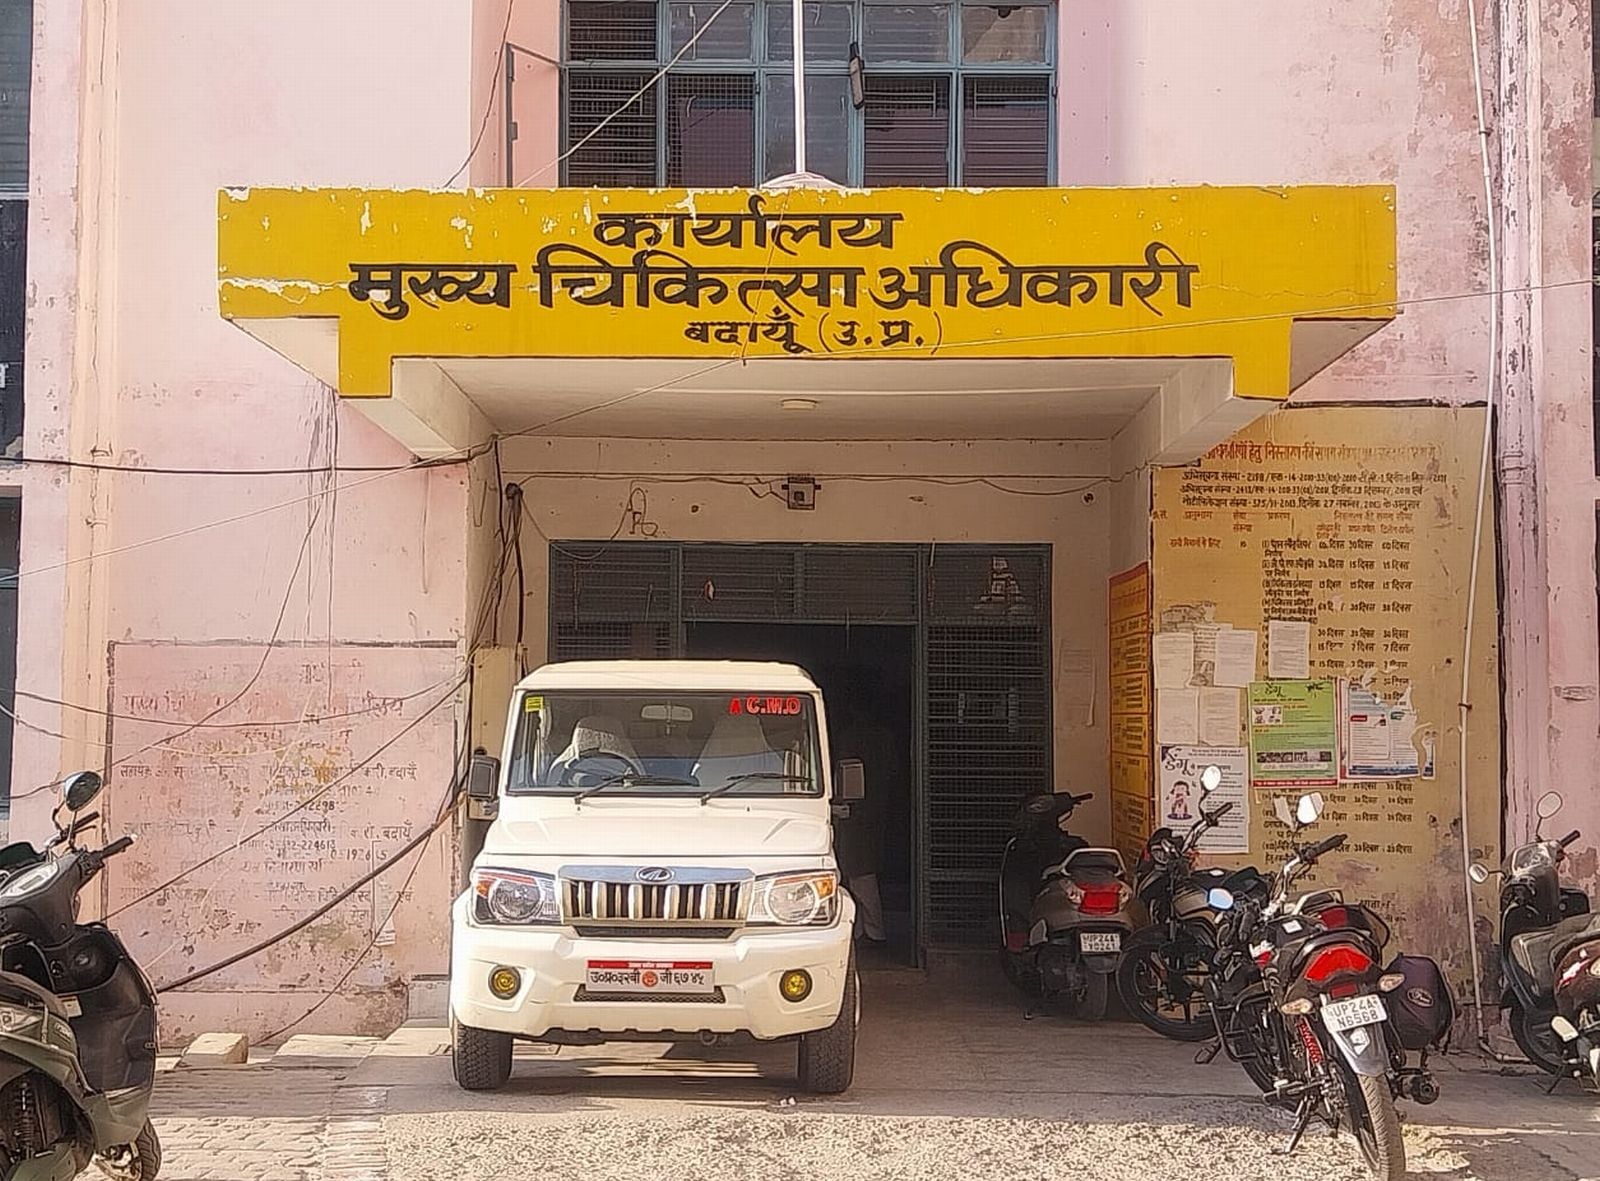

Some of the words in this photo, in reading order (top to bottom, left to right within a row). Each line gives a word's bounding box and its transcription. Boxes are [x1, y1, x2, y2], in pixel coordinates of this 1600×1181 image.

[594, 195, 904, 255] कार्यालय
[348, 263, 517, 320] मुख्य
[532, 243, 865, 316] चिकित्सा
[868, 241, 1199, 316] अधिकारी
[685, 307, 813, 353] बदायूँ
[818, 311, 944, 355] (उ.प्र.)
[729, 697, 741, 715] A
[1333, 998, 1376, 1017] UP24A
